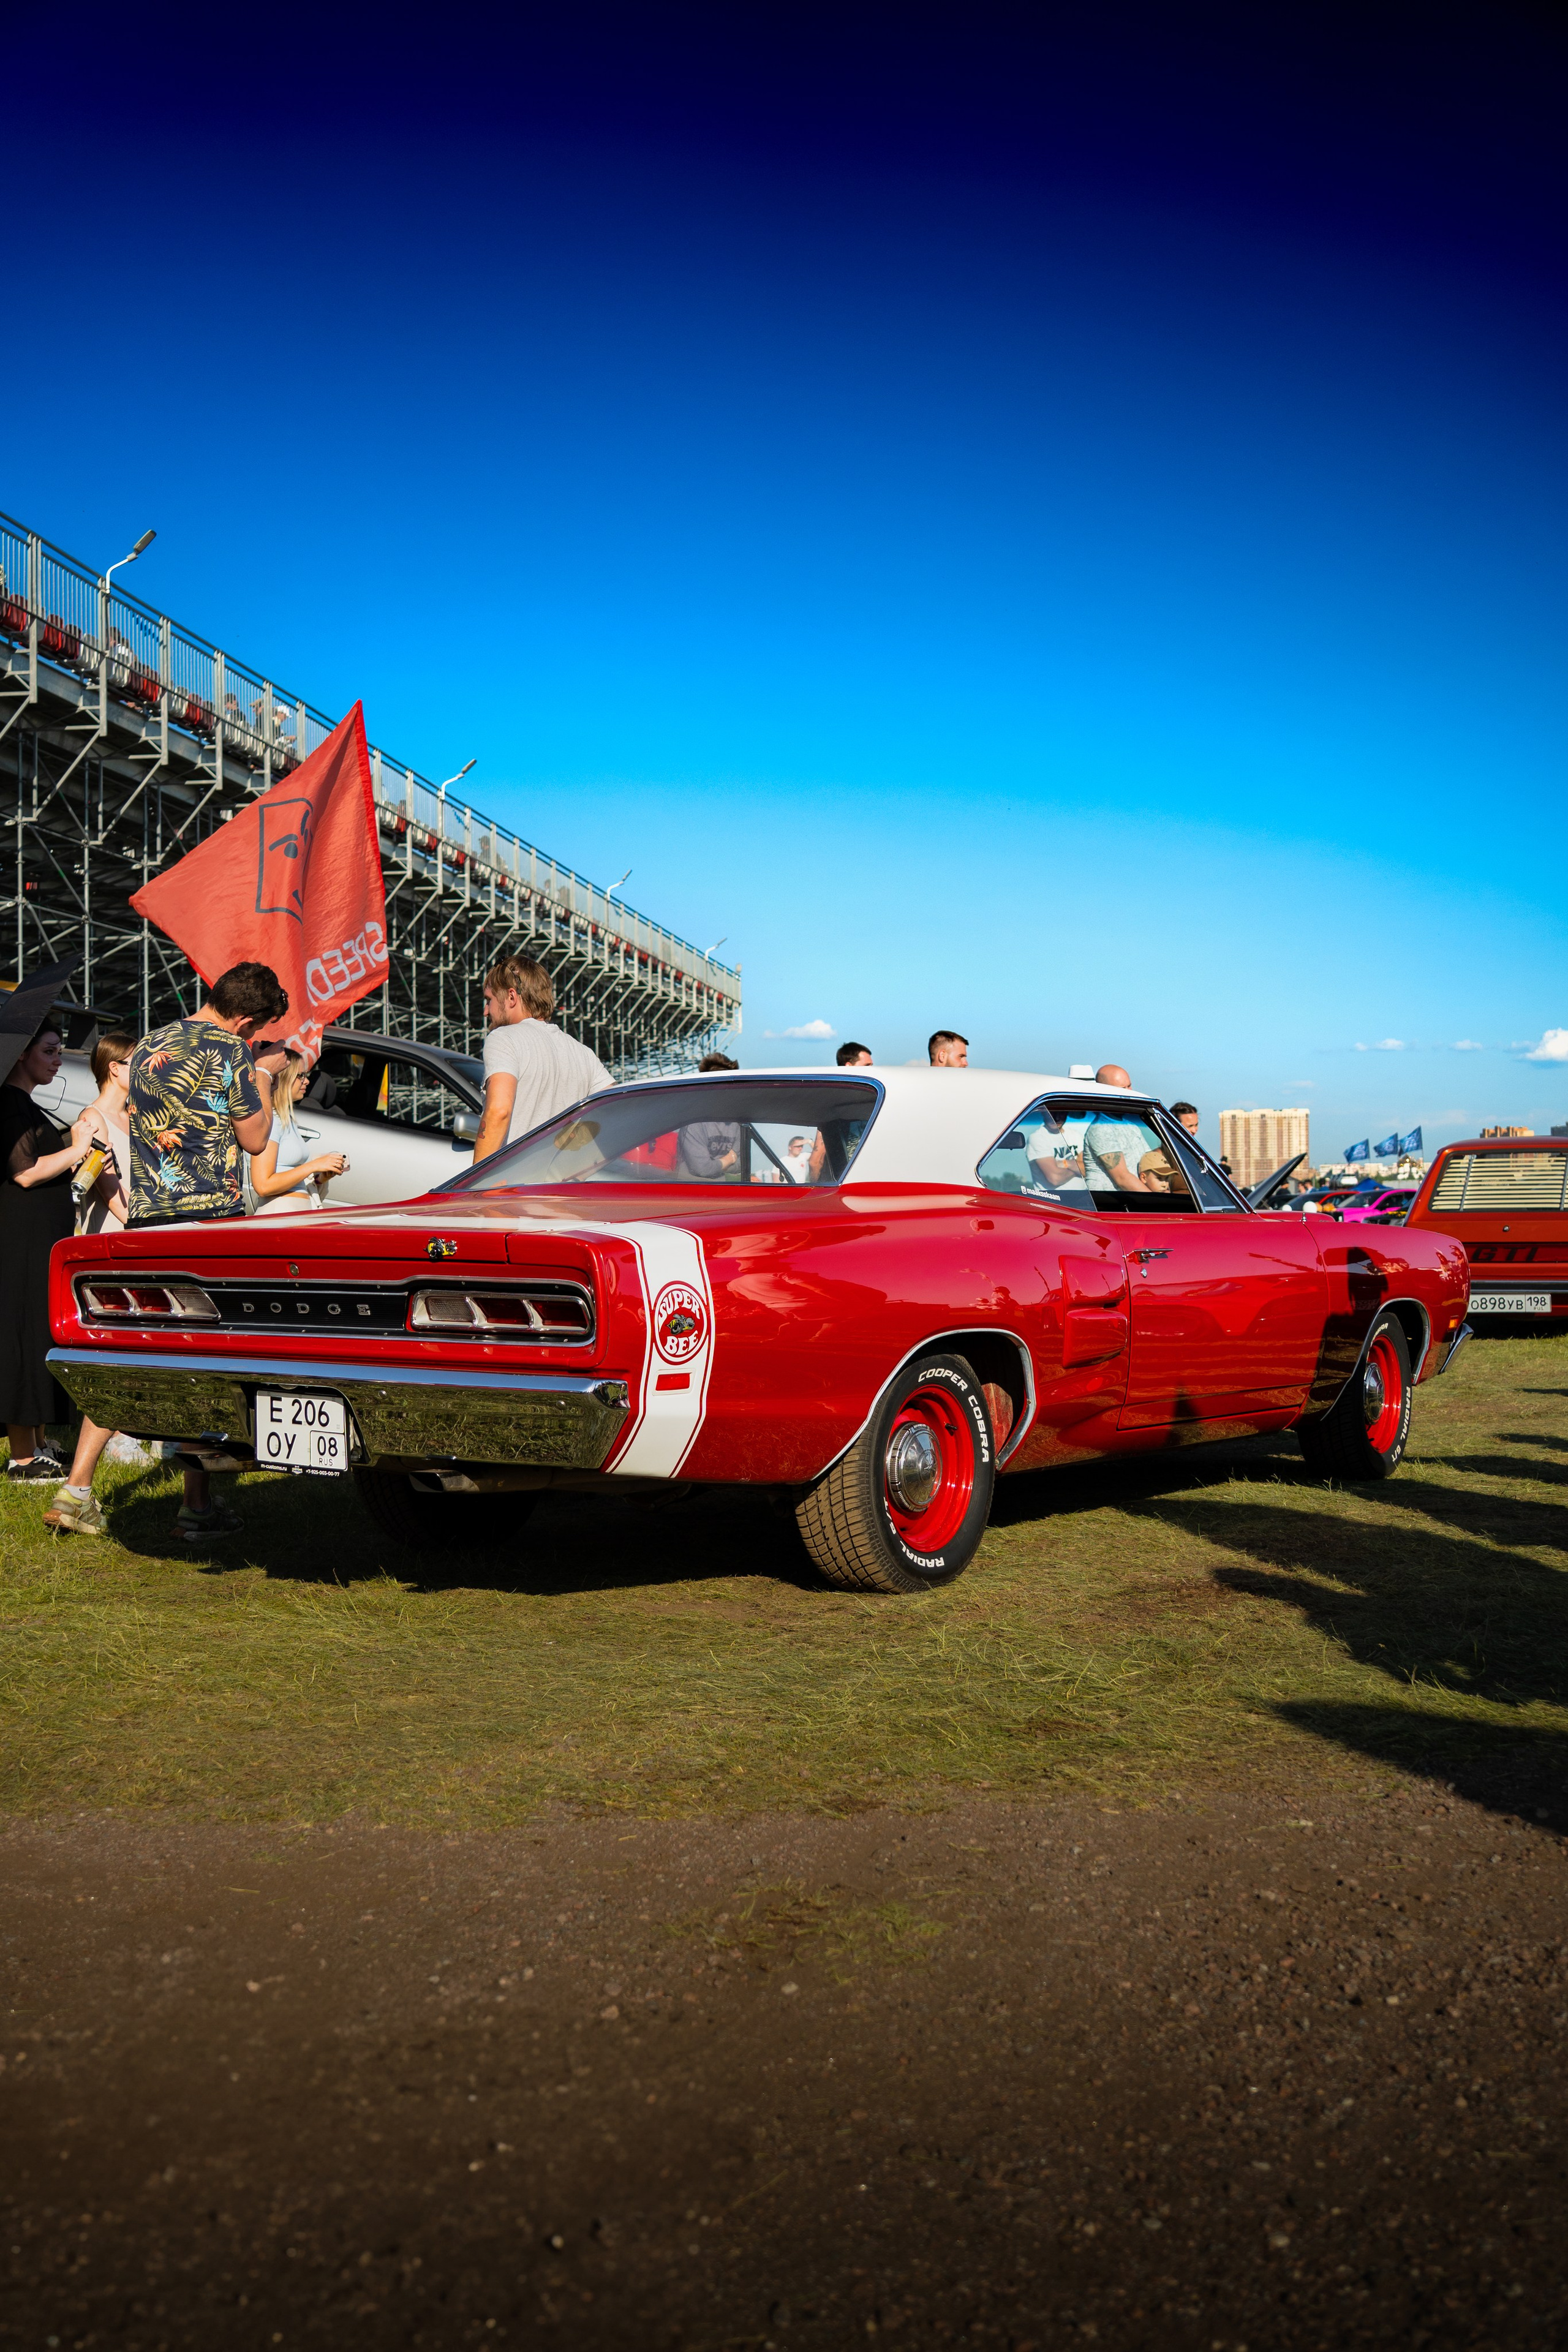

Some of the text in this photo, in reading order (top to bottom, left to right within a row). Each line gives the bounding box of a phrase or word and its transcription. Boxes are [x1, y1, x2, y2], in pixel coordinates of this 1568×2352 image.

[1472, 1246, 1539, 1262] GTI
[243, 1303, 371, 1316] DODGE
[658, 1290, 700, 1332] SUPER
[1527, 1297, 1547, 1306] 198
[664, 1330, 698, 1355] BEE
[270, 1396, 330, 1427] E 206
[918, 1368, 989, 1463] COOPER COBRA
[1400, 1386, 1411, 1440] RADIAL
[317, 1436, 338, 1457] 08
[900, 1540, 944, 1567] RADIAL
